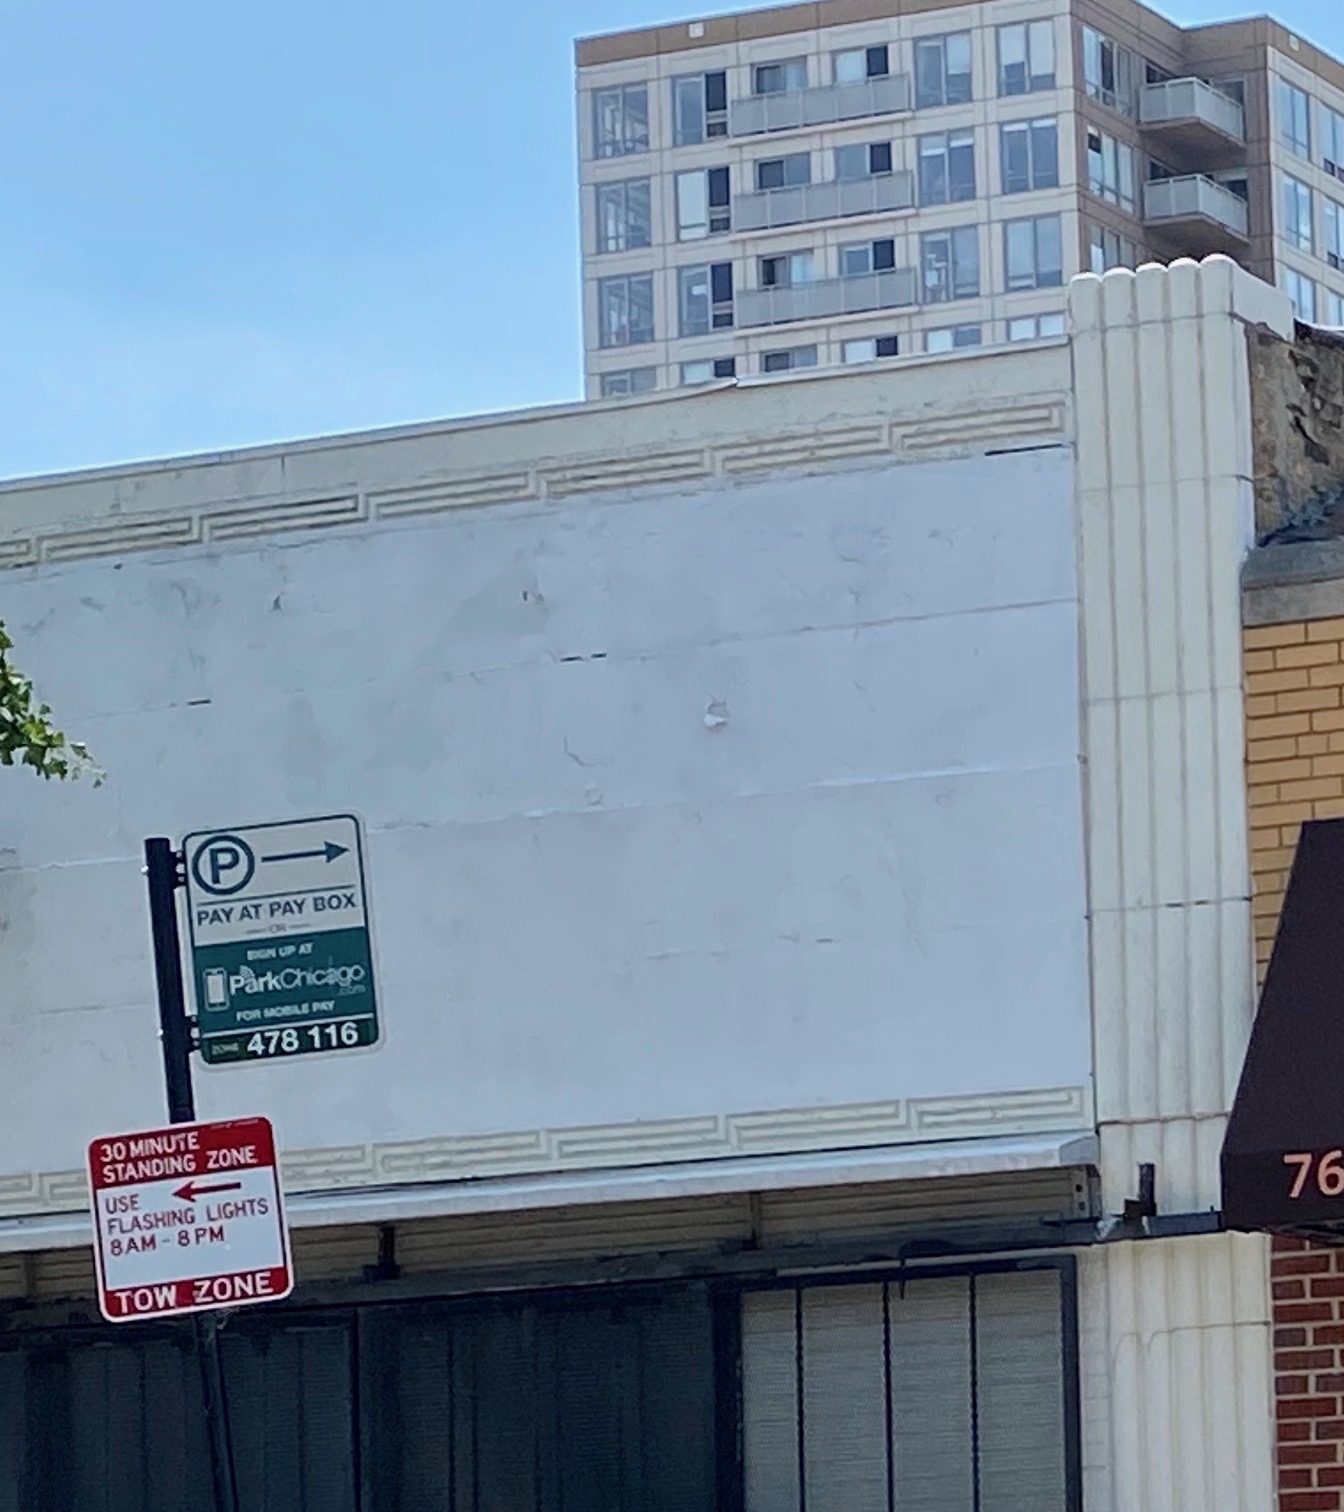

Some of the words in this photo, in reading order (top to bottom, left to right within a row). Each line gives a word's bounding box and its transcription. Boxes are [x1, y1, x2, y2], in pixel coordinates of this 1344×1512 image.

[209, 847, 240, 885] P
[197, 907, 234, 927] PAY
[239, 903, 262, 920] AT
[269, 898, 307, 918] PAY
[313, 892, 357, 913] BOX
[279, 945, 296, 957] UP
[299, 942, 314, 955] AT
[229, 963, 366, 996] ParkChicago
[236, 1009, 262, 1022] FOR
[264, 1003, 310, 1019] MOBILE
[312, 1000, 336, 1013] PAY
[247, 1028, 299, 1056] 478
[308, 1022, 359, 1049] 116
[100, 1142, 127, 1163] 30
[130, 1131, 200, 1159] MINUTE
[103, 1153, 196, 1183] STANDING
[206, 1145, 258, 1170] ZONE
[105, 1193, 140, 1215] USE
[107, 1207, 196, 1236] FLASHING
[206, 1197, 270, 1222] LIGHTS
[114, 1284, 177, 1314] TOW
[193, 1271, 273, 1304] ZONE
